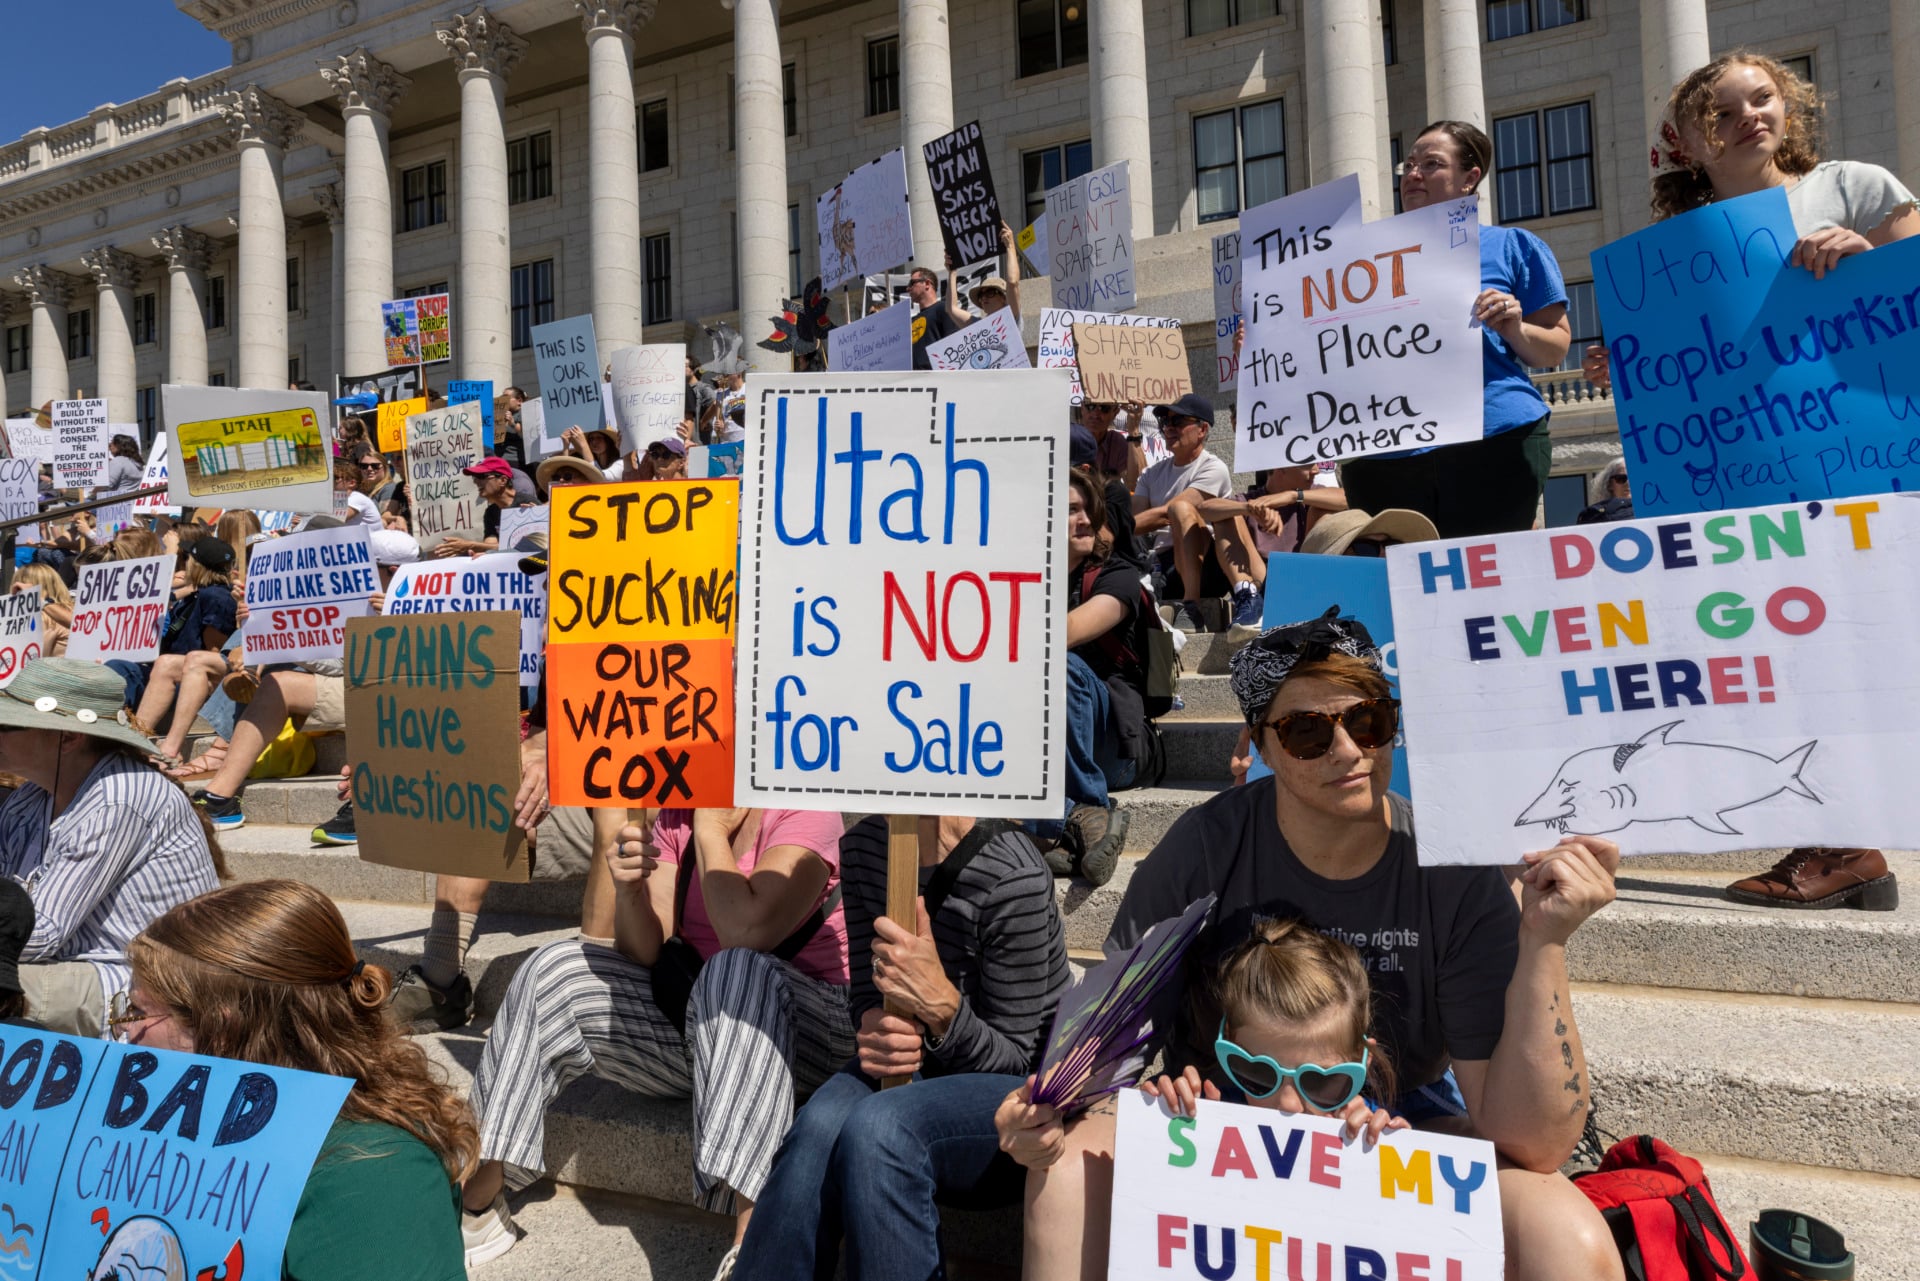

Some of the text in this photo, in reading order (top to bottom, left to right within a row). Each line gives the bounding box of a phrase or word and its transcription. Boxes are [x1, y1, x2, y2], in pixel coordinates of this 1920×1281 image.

[923, 124, 980, 163] UNPAID
[929, 146, 980, 191] UTAH
[942, 181, 986, 213] SAYS
[1048, 172, 1125, 216] THE GSL
[1056, 200, 1119, 246] CAN'T
[955, 224, 998, 266] NO!!
[1055, 233, 1127, 282] SPARE A
[1253, 225, 1333, 270] This
[1604, 209, 1790, 313] Utah
[1057, 269, 1130, 310] SQUARE
[1252, 292, 1284, 324] is
[1302, 244, 1423, 319] NOT
[417, 296, 448, 319] STOP
[1042, 310, 1075, 329] NO
[1084, 314, 1128, 326] DATA
[418, 316, 449, 331] CORRUPT
[421, 342, 450, 362] SWINDLE
[537, 336, 585, 359] THIS IS
[979, 333, 1000, 350] EYES
[1040, 346, 1074, 357] Build
[1084, 326, 1181, 360] SHARKS
[1244, 322, 1442, 387] the Place
[552, 362, 589, 383] OUR
[625, 350, 668, 370] COX
[1119, 358, 1143, 370] ARE
[1610, 313, 1748, 402] People
[450, 383, 468, 392] LETS
[547, 382, 599, 408] HOME!
[642, 392, 685, 405] GREAT
[1085, 372, 1189, 401] UNWELCOME
[66, 401, 82, 409] YOU
[386, 403, 408, 417] NO
[1247, 391, 1422, 442] for Data
[54, 417, 105, 426] WITHOUT THE
[60, 426, 98, 435] PEOPLES'
[221, 417, 272, 436] UTAH
[414, 417, 437, 439] SAVE
[443, 412, 472, 432] OUR
[649, 413, 680, 430] LAKE
[16, 435, 52, 446] WHALE
[60, 435, 99, 443] CONSENT,
[196, 431, 319, 477] NO THX
[410, 433, 474, 461] WATER, SAVE
[1285, 420, 1438, 465] Centers
[0, 458, 37, 485] COX
[54, 453, 85, 461] PEOPLE
[57, 461, 103, 470] DESTROY IT
[147, 467, 156, 477] IS
[413, 454, 476, 479] OUR AIR, SAVE
[774, 396, 990, 547] Utah
[63, 470, 98, 478] WITHOUT
[66, 479, 96, 487] YOURS.
[212, 480, 247, 492] EMISSIONS
[249, 477, 280, 488] ELEVATED
[1642, 436, 1920, 512] a great place
[5, 486, 25, 498] IS A
[415, 484, 433, 502] OUR
[418, 499, 474, 537] KILL A.I.
[568, 487, 714, 542] STOP
[250, 541, 369, 577] KEEP OUR AIR CLEAN
[1418, 501, 1880, 594] HE DOESN'T
[80, 562, 160, 605] SAVE GSL
[248, 568, 375, 603] & OUR LAKE SAFE
[413, 572, 533, 595] NOT ON THE
[554, 557, 734, 634] SUCKING
[0, 592, 41, 617] NTROL
[272, 606, 340, 630] STOP
[390, 598, 541, 618] GREAT SALT LAKE
[792, 570, 1042, 663] is NOT
[72, 603, 165, 651] STOP STRATOS
[1463, 586, 1827, 662] EVEN GO
[246, 629, 330, 652] STRATOS DATA
[349, 621, 495, 692] UTAHNS
[596, 643, 695, 691] OUR
[1561, 655, 1777, 716] HERE!
[376, 695, 466, 755] Have
[563, 686, 725, 749] WATER
[765, 675, 1005, 778] for Sale
[583, 745, 693, 805] COX
[352, 761, 510, 833] Questions
[1371, 928, 1420, 950] rights
[1378, 953, 1404, 971] all.
[0, 1036, 83, 1111] OD
[102, 1051, 278, 1148] BAD
[1167, 1116, 1487, 1215] SAVE MY
[76, 1135, 270, 1233] CANADIAN
